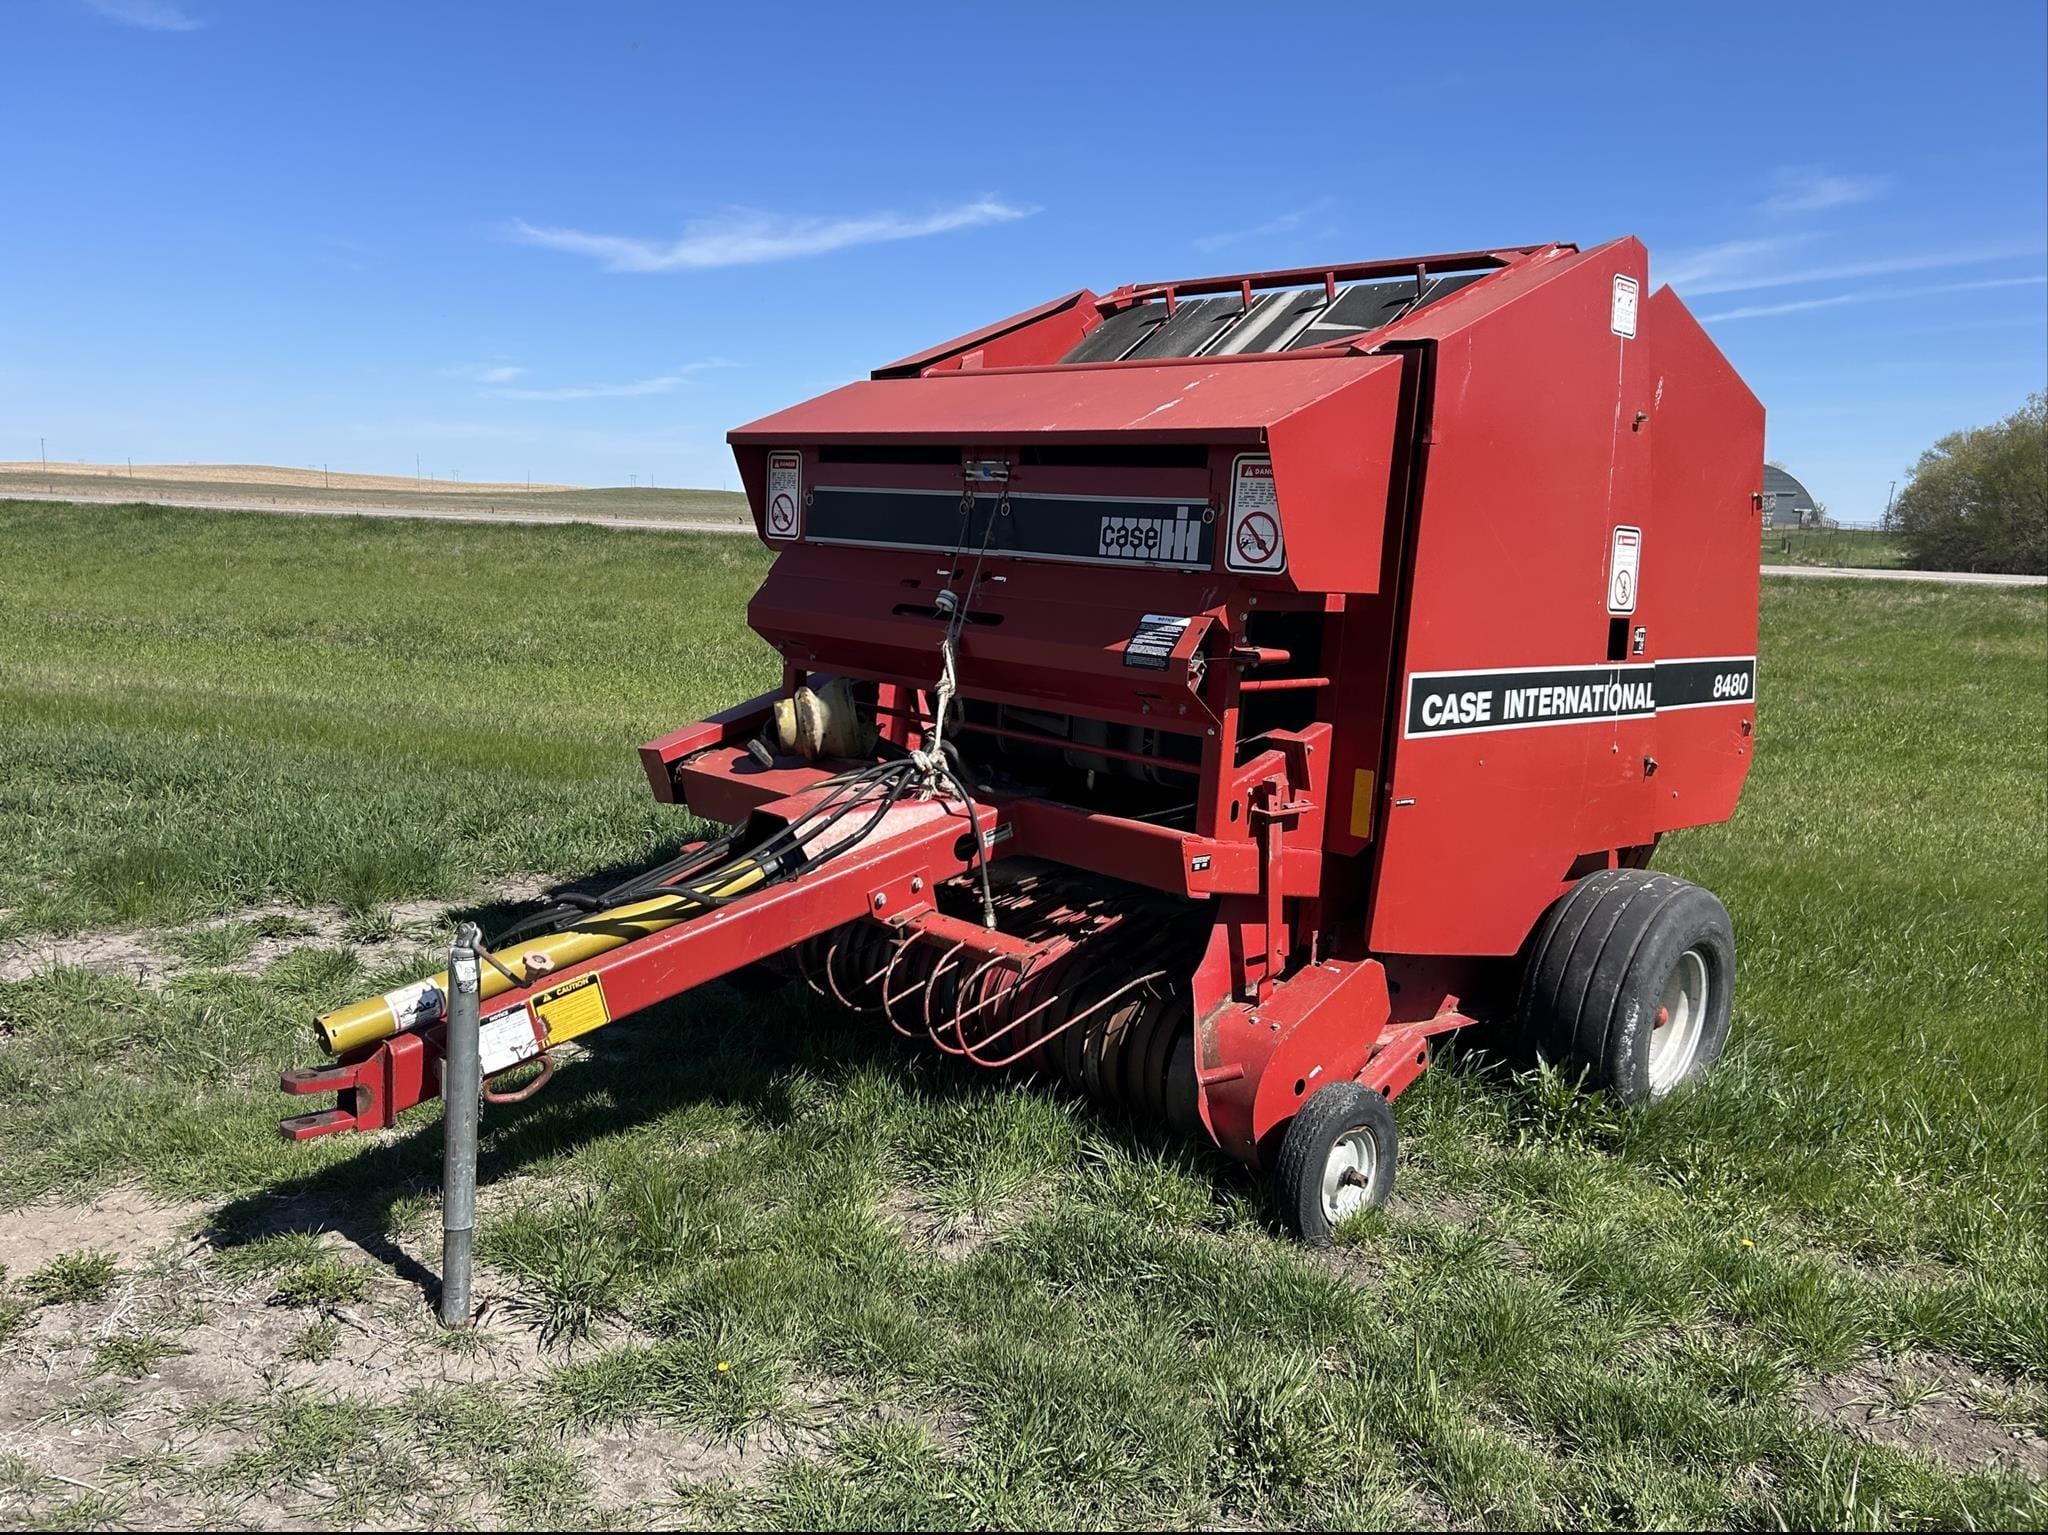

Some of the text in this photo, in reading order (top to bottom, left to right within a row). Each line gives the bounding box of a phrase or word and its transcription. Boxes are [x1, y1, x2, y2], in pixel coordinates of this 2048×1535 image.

[1100, 519, 1161, 557] case
[1712, 672, 1749, 699] 8480
[1421, 682, 1656, 727] CASE INTERNATIONAL
[556, 978, 589, 996] CAUTION
[489, 1010, 509, 1022] NOTICE
